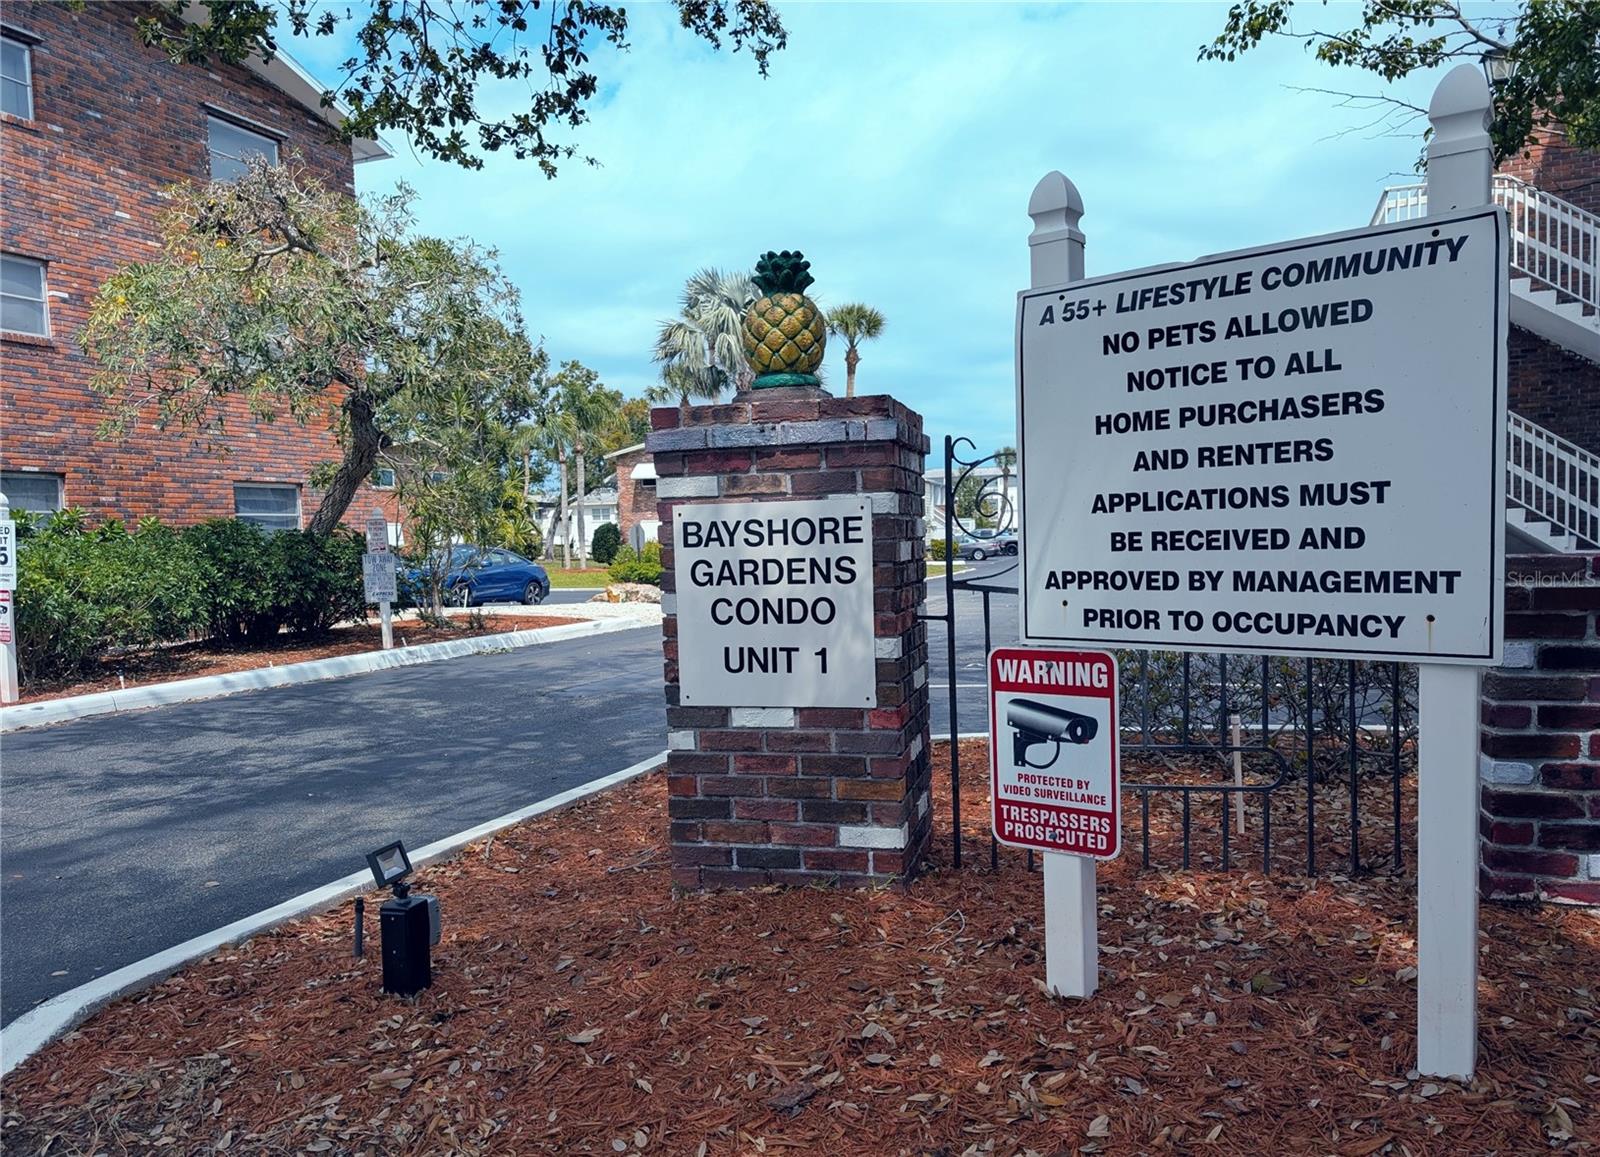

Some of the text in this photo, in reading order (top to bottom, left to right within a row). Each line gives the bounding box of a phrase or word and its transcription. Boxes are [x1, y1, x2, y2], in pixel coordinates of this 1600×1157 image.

[1038, 235, 1469, 326] A 55+ LIFESTYLE COMMUNITY
[1102, 298, 1374, 356] NO PETS ALLOWED
[1126, 348, 1342, 393] NOTICE TO ALL
[1095, 388, 1386, 436] HOME PURCHASERS
[1132, 438, 1334, 472] AND RENTERS
[1091, 480, 1391, 514] APPLICATIONS MUST
[682, 516, 864, 548] BAYSHORE
[1110, 526, 1366, 552] BE RECEIVED AND
[690, 555, 857, 587] GARDENS
[1044, 570, 1462, 595] APPROVED BY MANAGEMENT
[710, 596, 836, 625] CONDO
[1082, 608, 1406, 639] PRIOR TO OCCUPANCY
[724, 646, 827, 674] UNIT 1
[996, 658, 1109, 689] WARNING
[1003, 784, 1107, 806] VIDEO SURVEILLANCE
[1017, 773, 1090, 791] PROTECTED BY
[1000, 804, 1111, 833] TRESPASSERS
[1004, 821, 1108, 850] PROSECUTED
